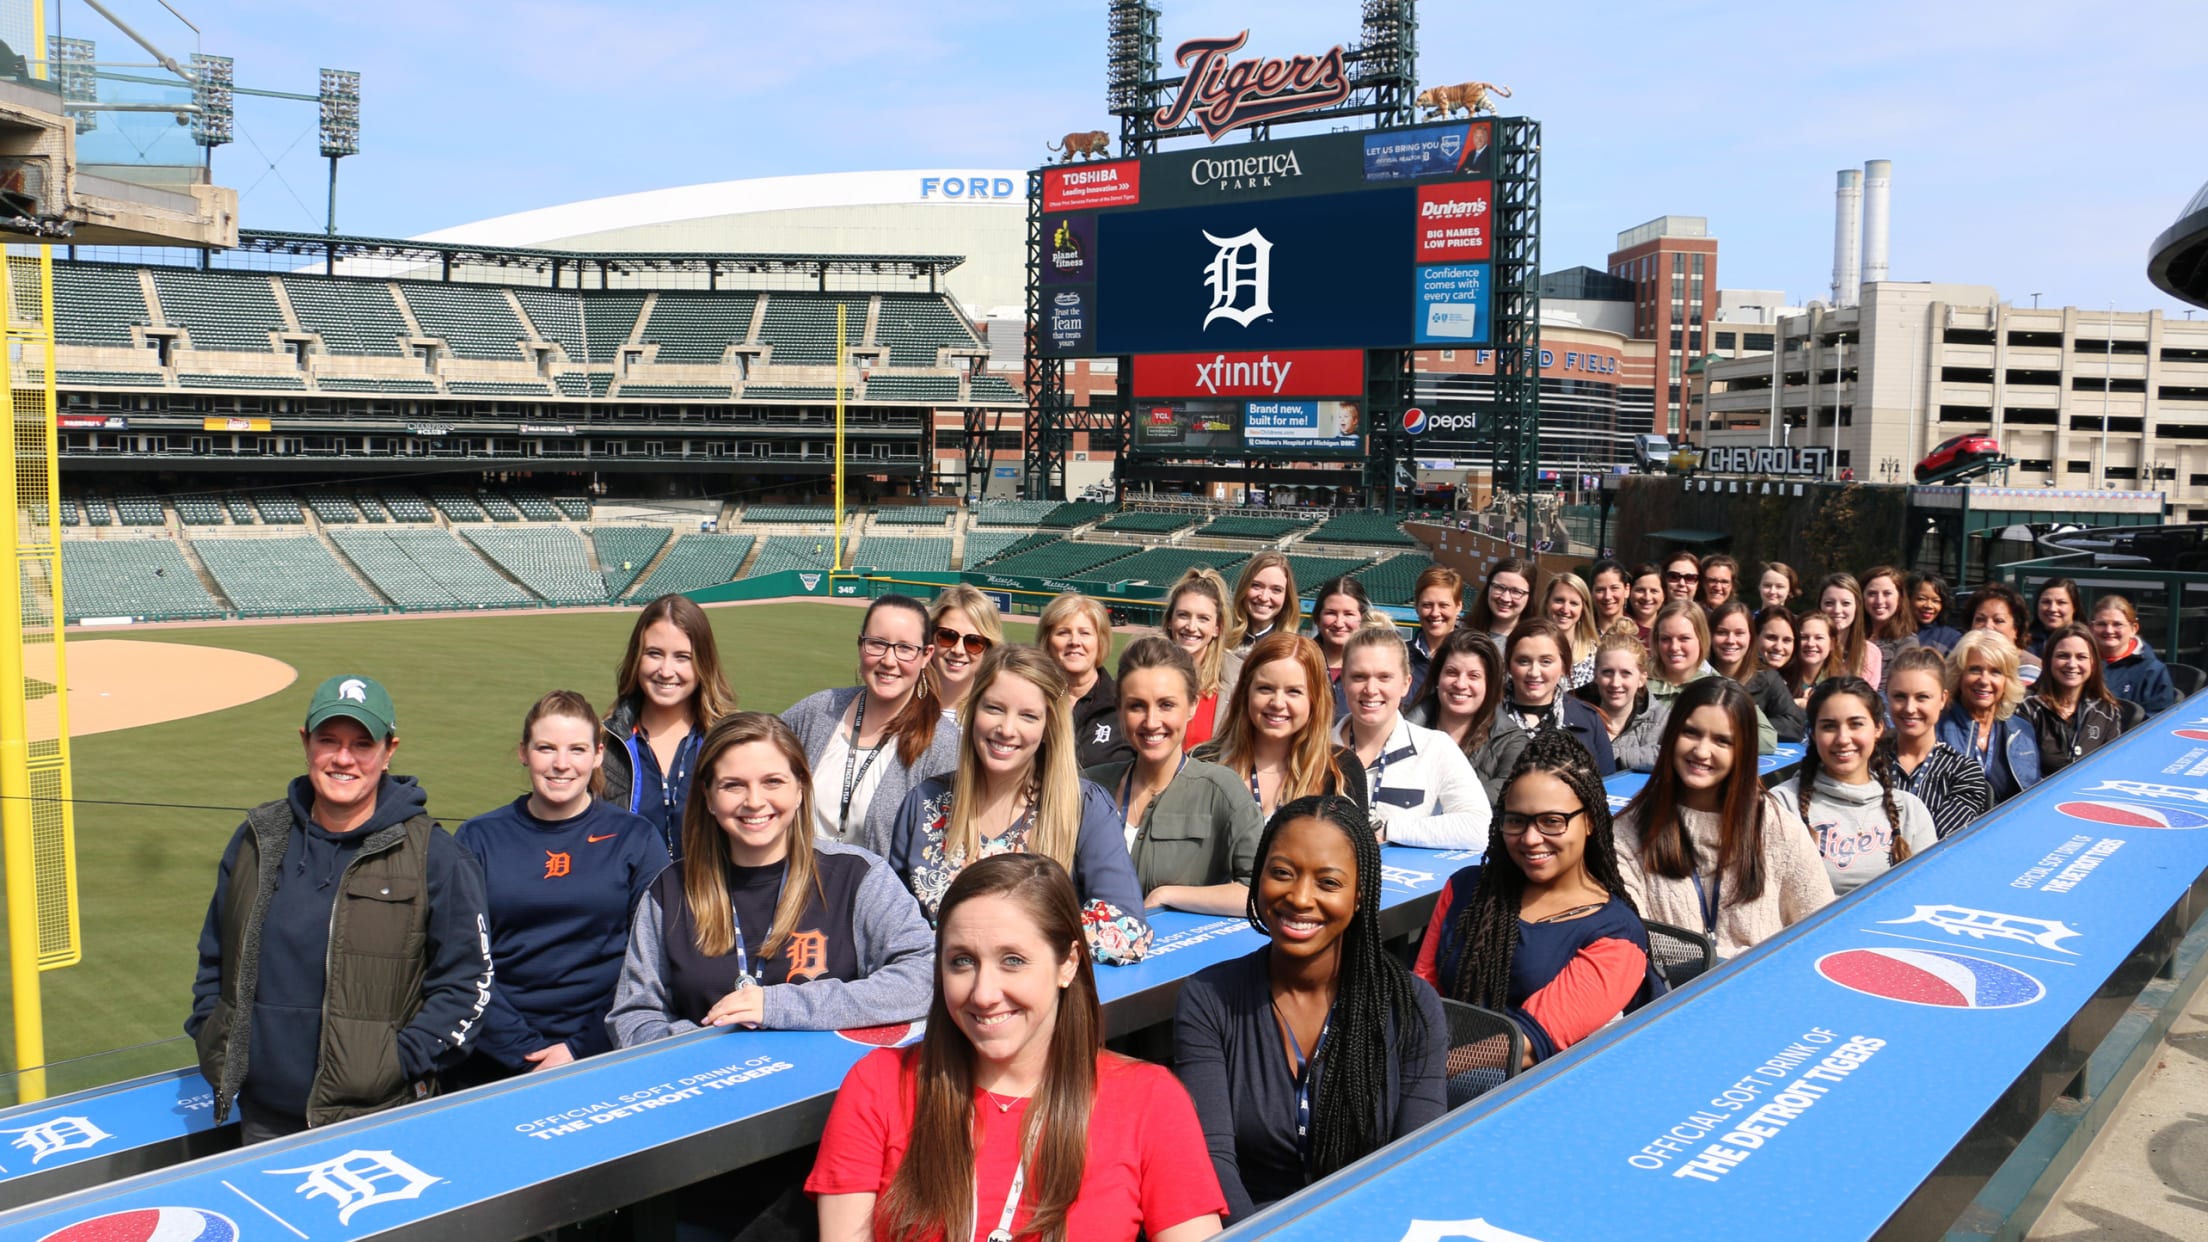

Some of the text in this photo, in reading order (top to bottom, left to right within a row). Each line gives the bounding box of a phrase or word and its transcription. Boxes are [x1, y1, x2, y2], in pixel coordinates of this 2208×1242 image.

[1154, 28, 1350, 143] Tigers
[1366, 147, 1380, 156] LET
[1382, 145, 1393, 154] US
[1395, 142, 1420, 153] BRING
[1422, 141, 1439, 151] YOU
[1062, 168, 1118, 186] TOSHIBA
[1220, 176, 1272, 190] PARK
[921, 177, 1014, 199] FORD
[1062, 184, 1118, 197] Leading Innovation
[1422, 198, 1487, 217] Dunham's
[1426, 228, 1480, 239] BIG NAMES
[1424, 237, 1483, 249] LOW PRICES
[1052, 251, 1078, 262] planet
[1056, 259, 1084, 268] fitness
[1424, 268, 1480, 279] Confidence
[1424, 278, 1480, 290] comes with
[1424, 292, 1450, 303] every
[1055, 307, 1080, 316] Trust the
[1052, 316, 1082, 331] Team
[1053, 331, 1082, 340] that treats
[1058, 340, 1075, 349] yours
[1565, 351, 1616, 375] FIELD
[1195, 354, 1292, 394] xfinity
[1154, 412, 1170, 420] TCL
[1249, 403, 1304, 415] Brand new,
[1249, 415, 1271, 426] built
[1273, 415, 1287, 426] for
[1288, 415, 1308, 426] me!
[1428, 412, 1476, 431] pepsi
[1283, 440, 1306, 448] Hospital
[1313, 440, 1340, 448] Michigan
[1708, 448, 1827, 475] CHEVROLET
[1684, 480, 1803, 497] FOUNTAIN
[543, 850, 571, 880] D
[1156, 931, 1192, 943] SOFT
[1189, 921, 1231, 933] DRINK
[1148, 933, 1216, 956] DETROIT
[786, 928, 829, 983] D
[451, 912, 495, 1046] carhartt
[515, 1055, 773, 1133] OFFICIAL SOFT DRINK OF
[528, 1061, 794, 1140] THE DETROIT TIGERS
[1627, 1026, 1838, 1170] OFFICIAL SOFT DRINK OF
[1672, 1035, 1887, 1182] THE DETROIT TIGERS
